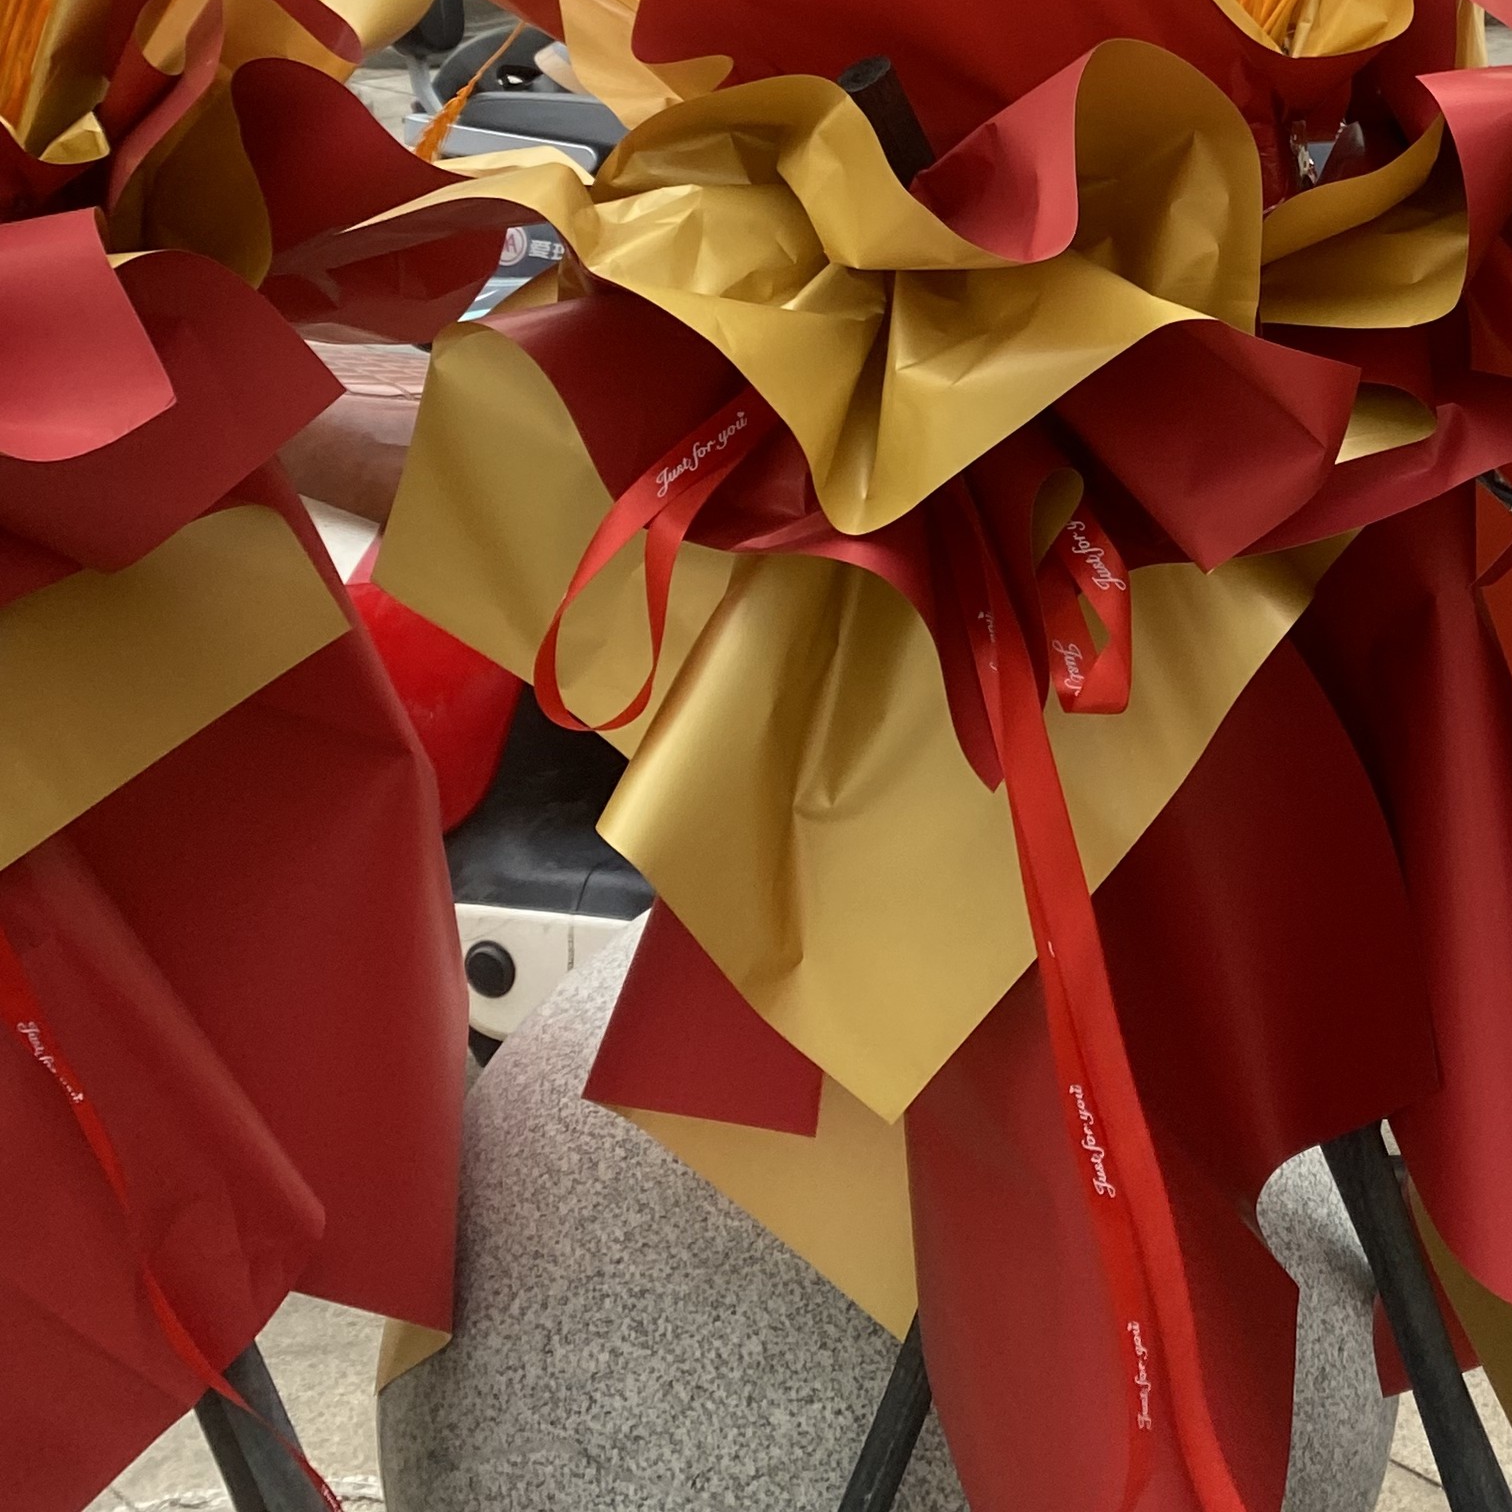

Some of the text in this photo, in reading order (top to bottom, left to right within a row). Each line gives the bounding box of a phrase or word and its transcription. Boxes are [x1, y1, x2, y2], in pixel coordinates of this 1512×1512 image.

[656, 458, 691, 498] Just
[1085, 555, 1126, 591] Just
[1052, 639, 1084, 683] Just
[1091, 1153, 1116, 1198] Just
